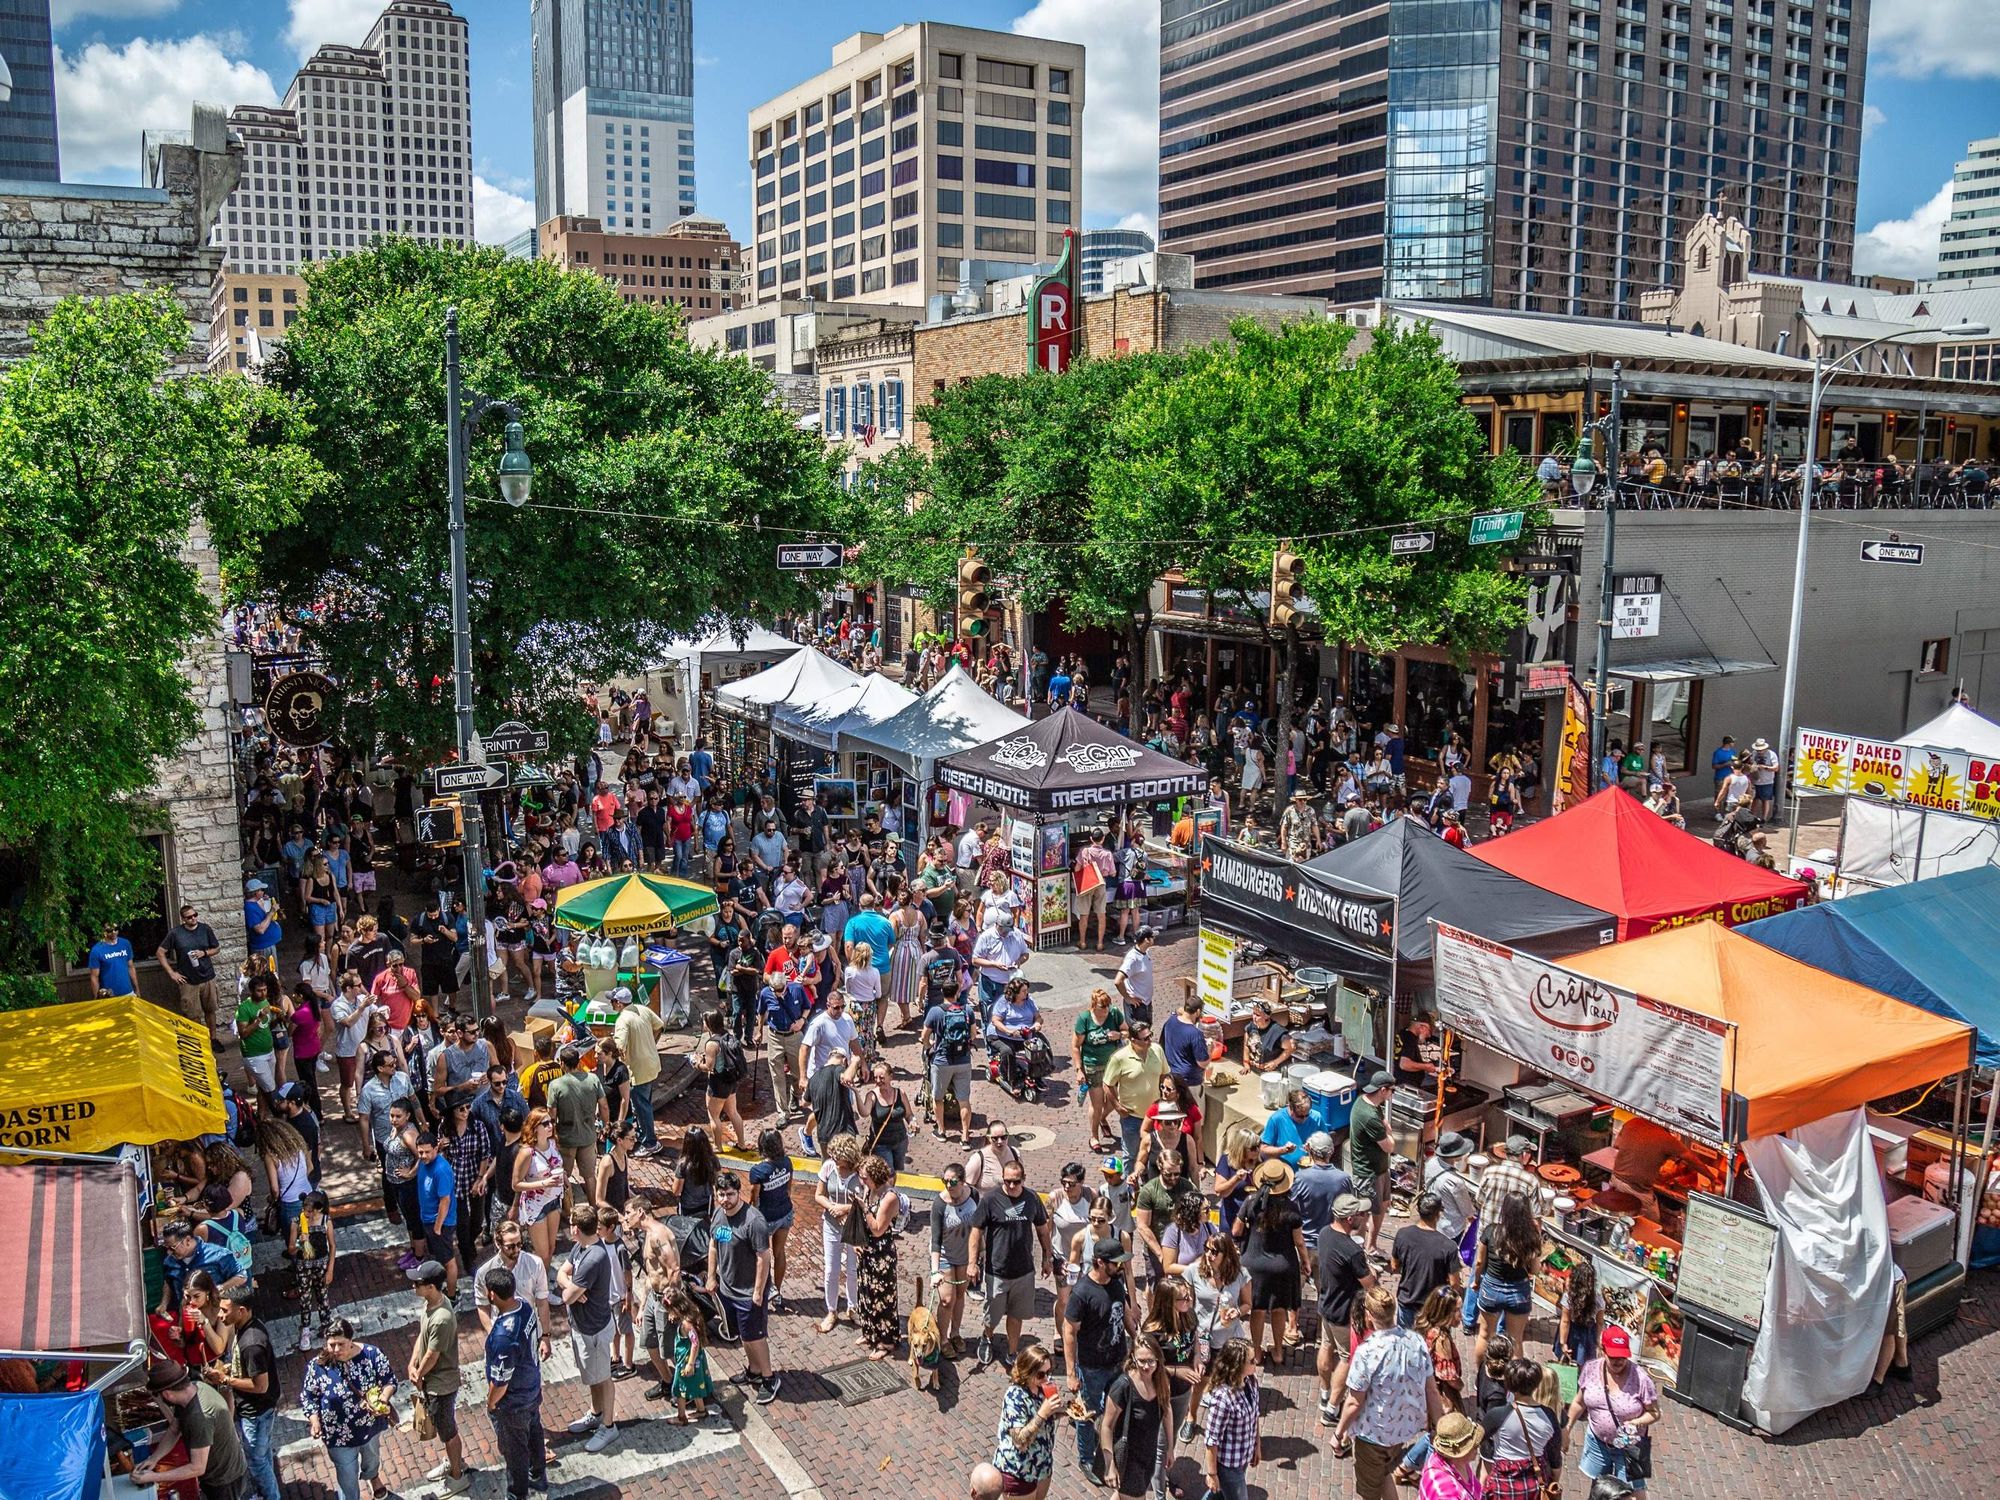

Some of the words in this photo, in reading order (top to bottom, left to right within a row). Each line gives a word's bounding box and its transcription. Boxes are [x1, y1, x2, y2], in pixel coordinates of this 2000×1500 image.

[1477, 518, 1508, 531] Trinity
[1510, 515, 1518, 524] ST
[1396, 541, 1406, 549] ONE
[1410, 540, 1421, 548] WAY
[1476, 534, 1486, 542] 500
[1880, 548, 1895, 556] ONE
[1899, 550, 1916, 558] WAY
[1623, 578, 1636, 593] IRON
[1636, 576, 1656, 593] CACTUS
[480, 738, 522, 752] TRINITY
[1802, 734, 1849, 753] TURKEY
[1856, 743, 1902, 761] BAKED
[784, 752, 801, 762] ONE
[806, 752, 823, 761] WAY
[1068, 743, 1131, 765] PECAN
[1808, 748, 1840, 764] LEGS
[1852, 757, 1903, 779] POTATO
[444, 776, 464, 786] ONE
[466, 772, 486, 783] WAY
[940, 766, 982, 792] MERCH
[985, 779, 1030, 806] BOOTH
[1052, 784, 1126, 808] MERCH
[1130, 775, 1197, 799] BOOTH
[1906, 792, 1960, 812] SAUSAGE
[1964, 800, 2000, 817] SANDWI
[1212, 854, 1283, 902] HAMBURGERS
[1297, 882, 1342, 925] RIBBON
[1342, 902, 1377, 937] FRIES
[674, 904, 717, 923] LEMONADE
[1732, 901, 1769, 922] CORN
[607, 919, 670, 935] LEMONADE
[1445, 927, 1498, 952] SAVORY
[105, 951, 121, 960] Hurley
[1537, 974, 1603, 1017] Crêpe
[1590, 1005, 1619, 1023] CRAZY
[1654, 1002, 1712, 1028] SWEET
[1685, 1024, 1706, 1035] BANANA
[538, 1068, 563, 1083] GWYNN
[1648, 1092, 1658, 1100] we
[0, 1101, 96, 1130] ASTED
[1655, 1101, 1675, 1113] cater
[0, 1125, 70, 1148] CORN
[1692, 1132, 1700, 1141] TX
[1702, 1136, 1722, 1150] 78704
[1694, 1207, 1718, 1219] SAVORY
[1743, 1226, 1766, 1238] SWEET
[503, 1316, 515, 1332] 4
